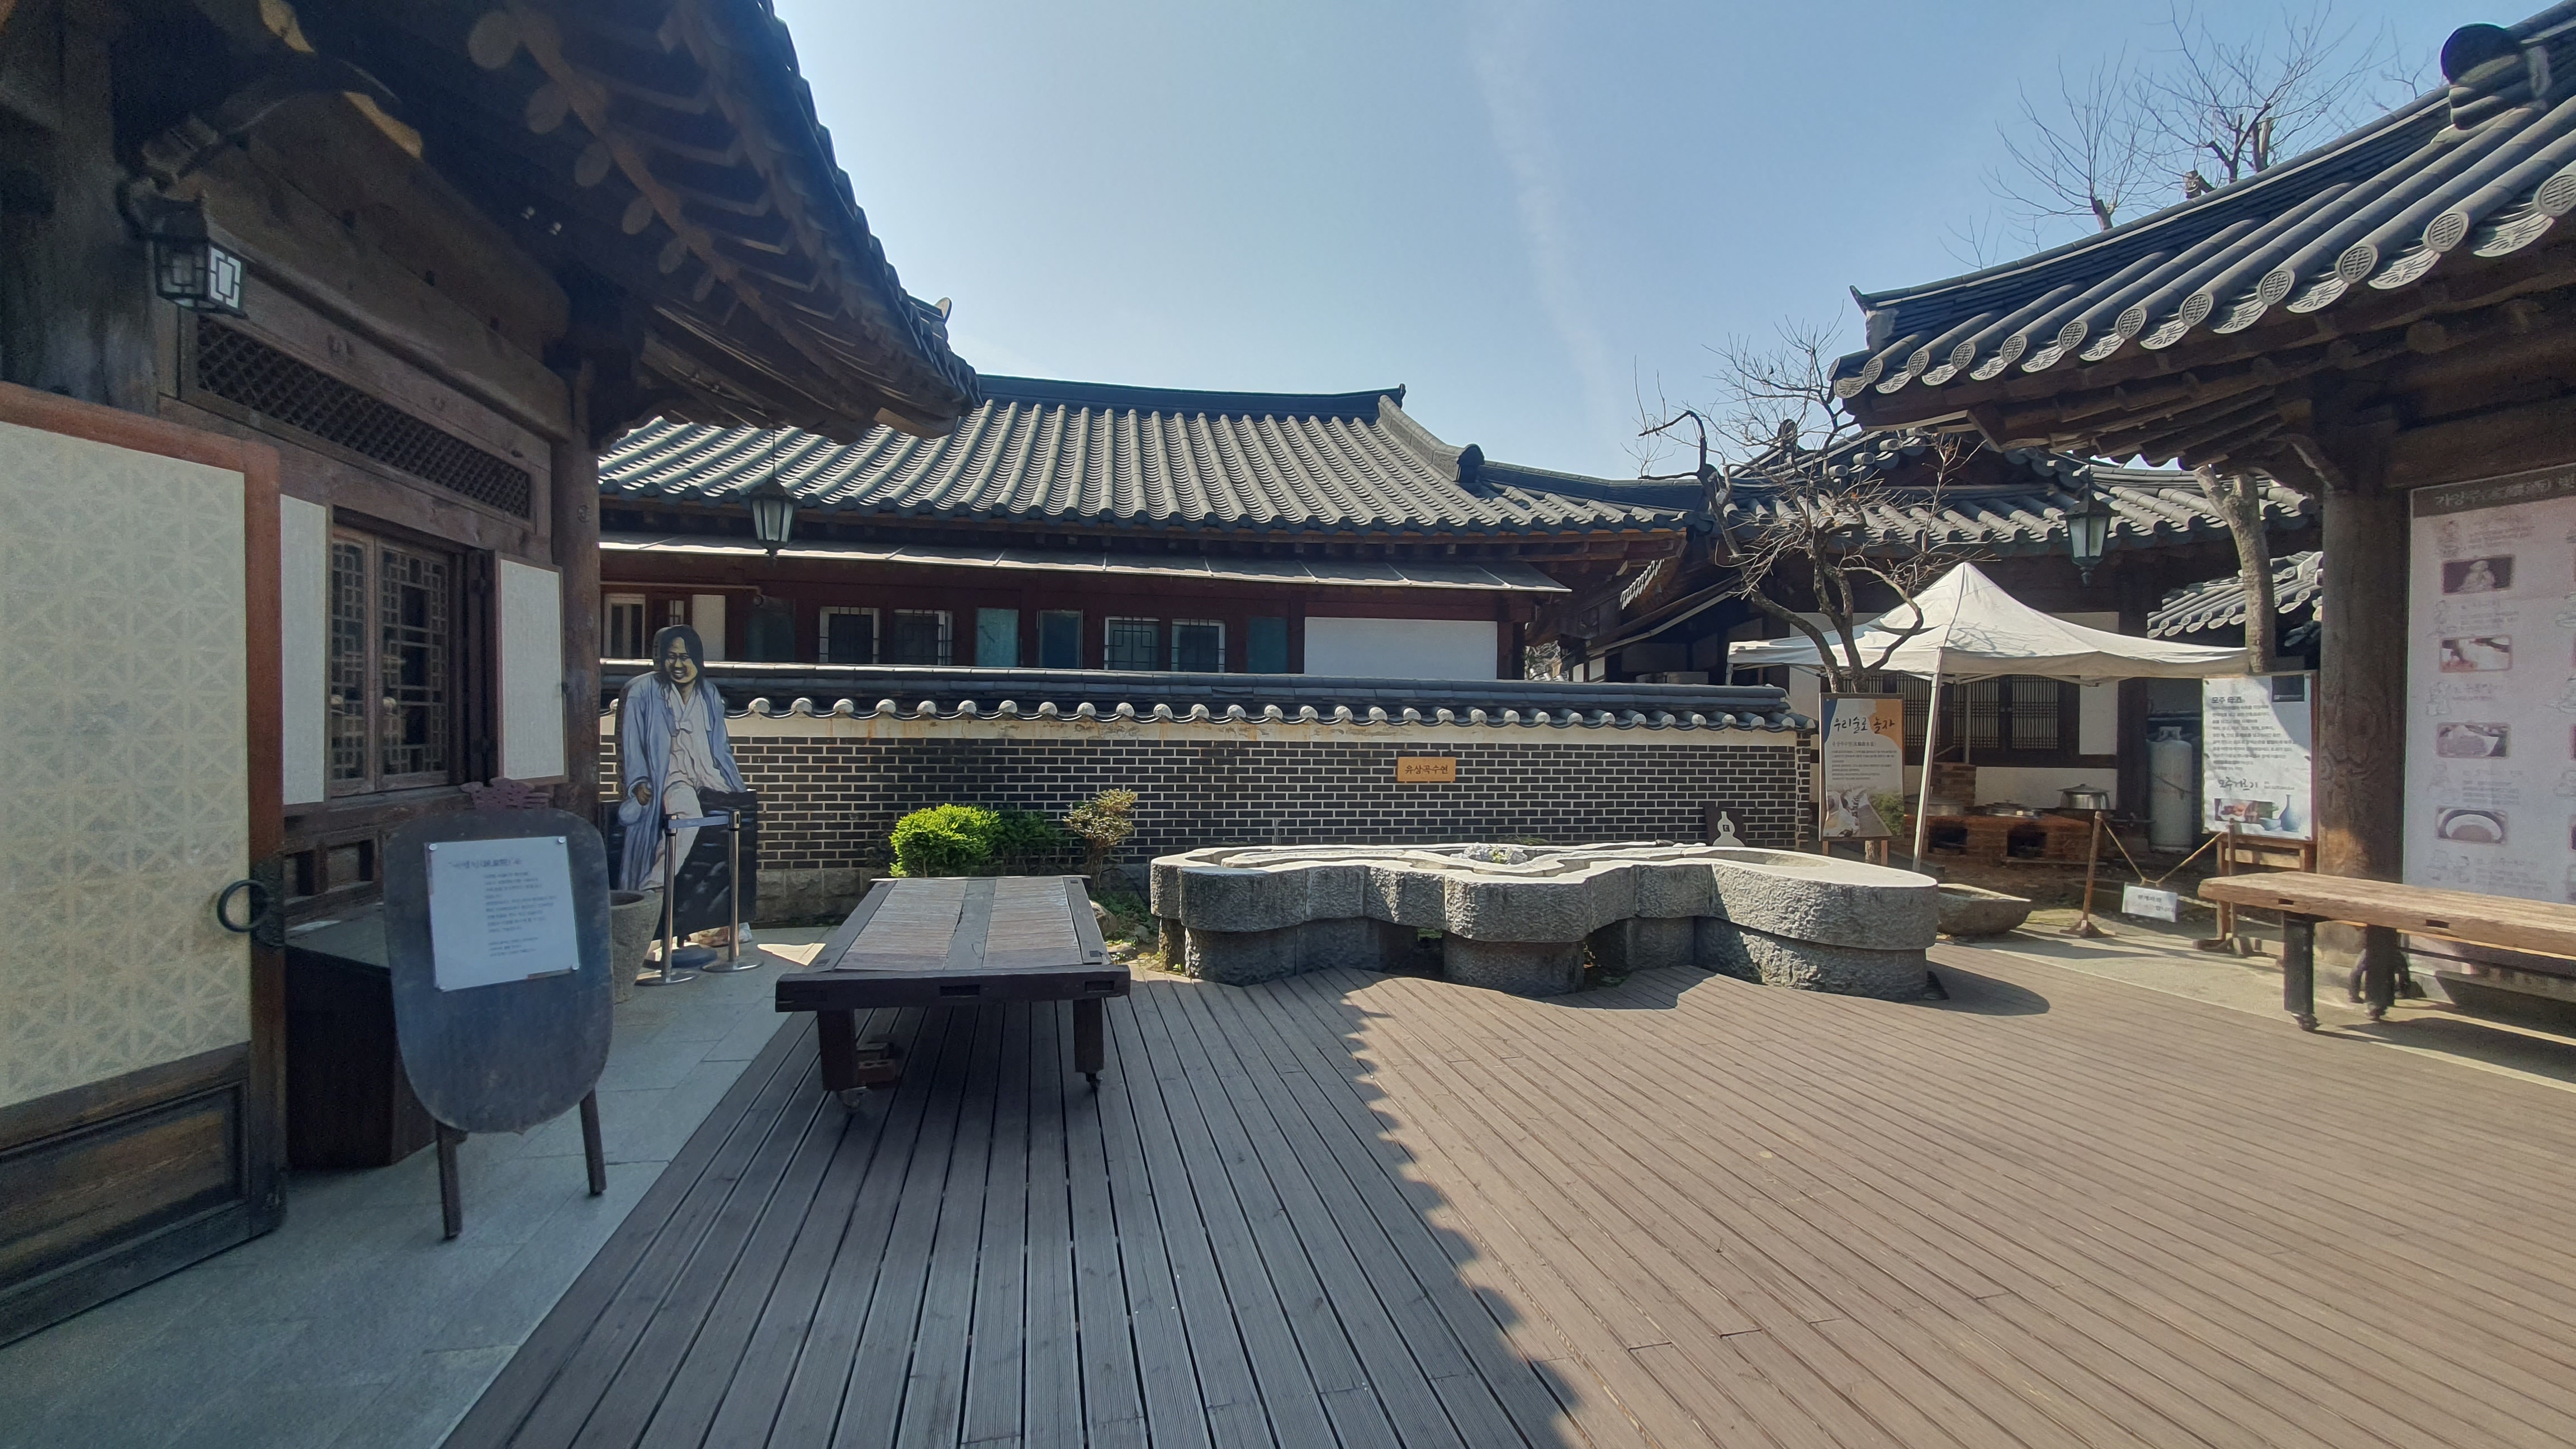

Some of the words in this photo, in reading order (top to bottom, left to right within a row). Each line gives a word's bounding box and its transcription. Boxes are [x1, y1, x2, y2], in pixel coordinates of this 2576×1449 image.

[1834, 716, 1868, 734] 우리술로
[1873, 716, 1895, 734] 놀자
[1405, 765, 1449, 774] 유상곡수연
